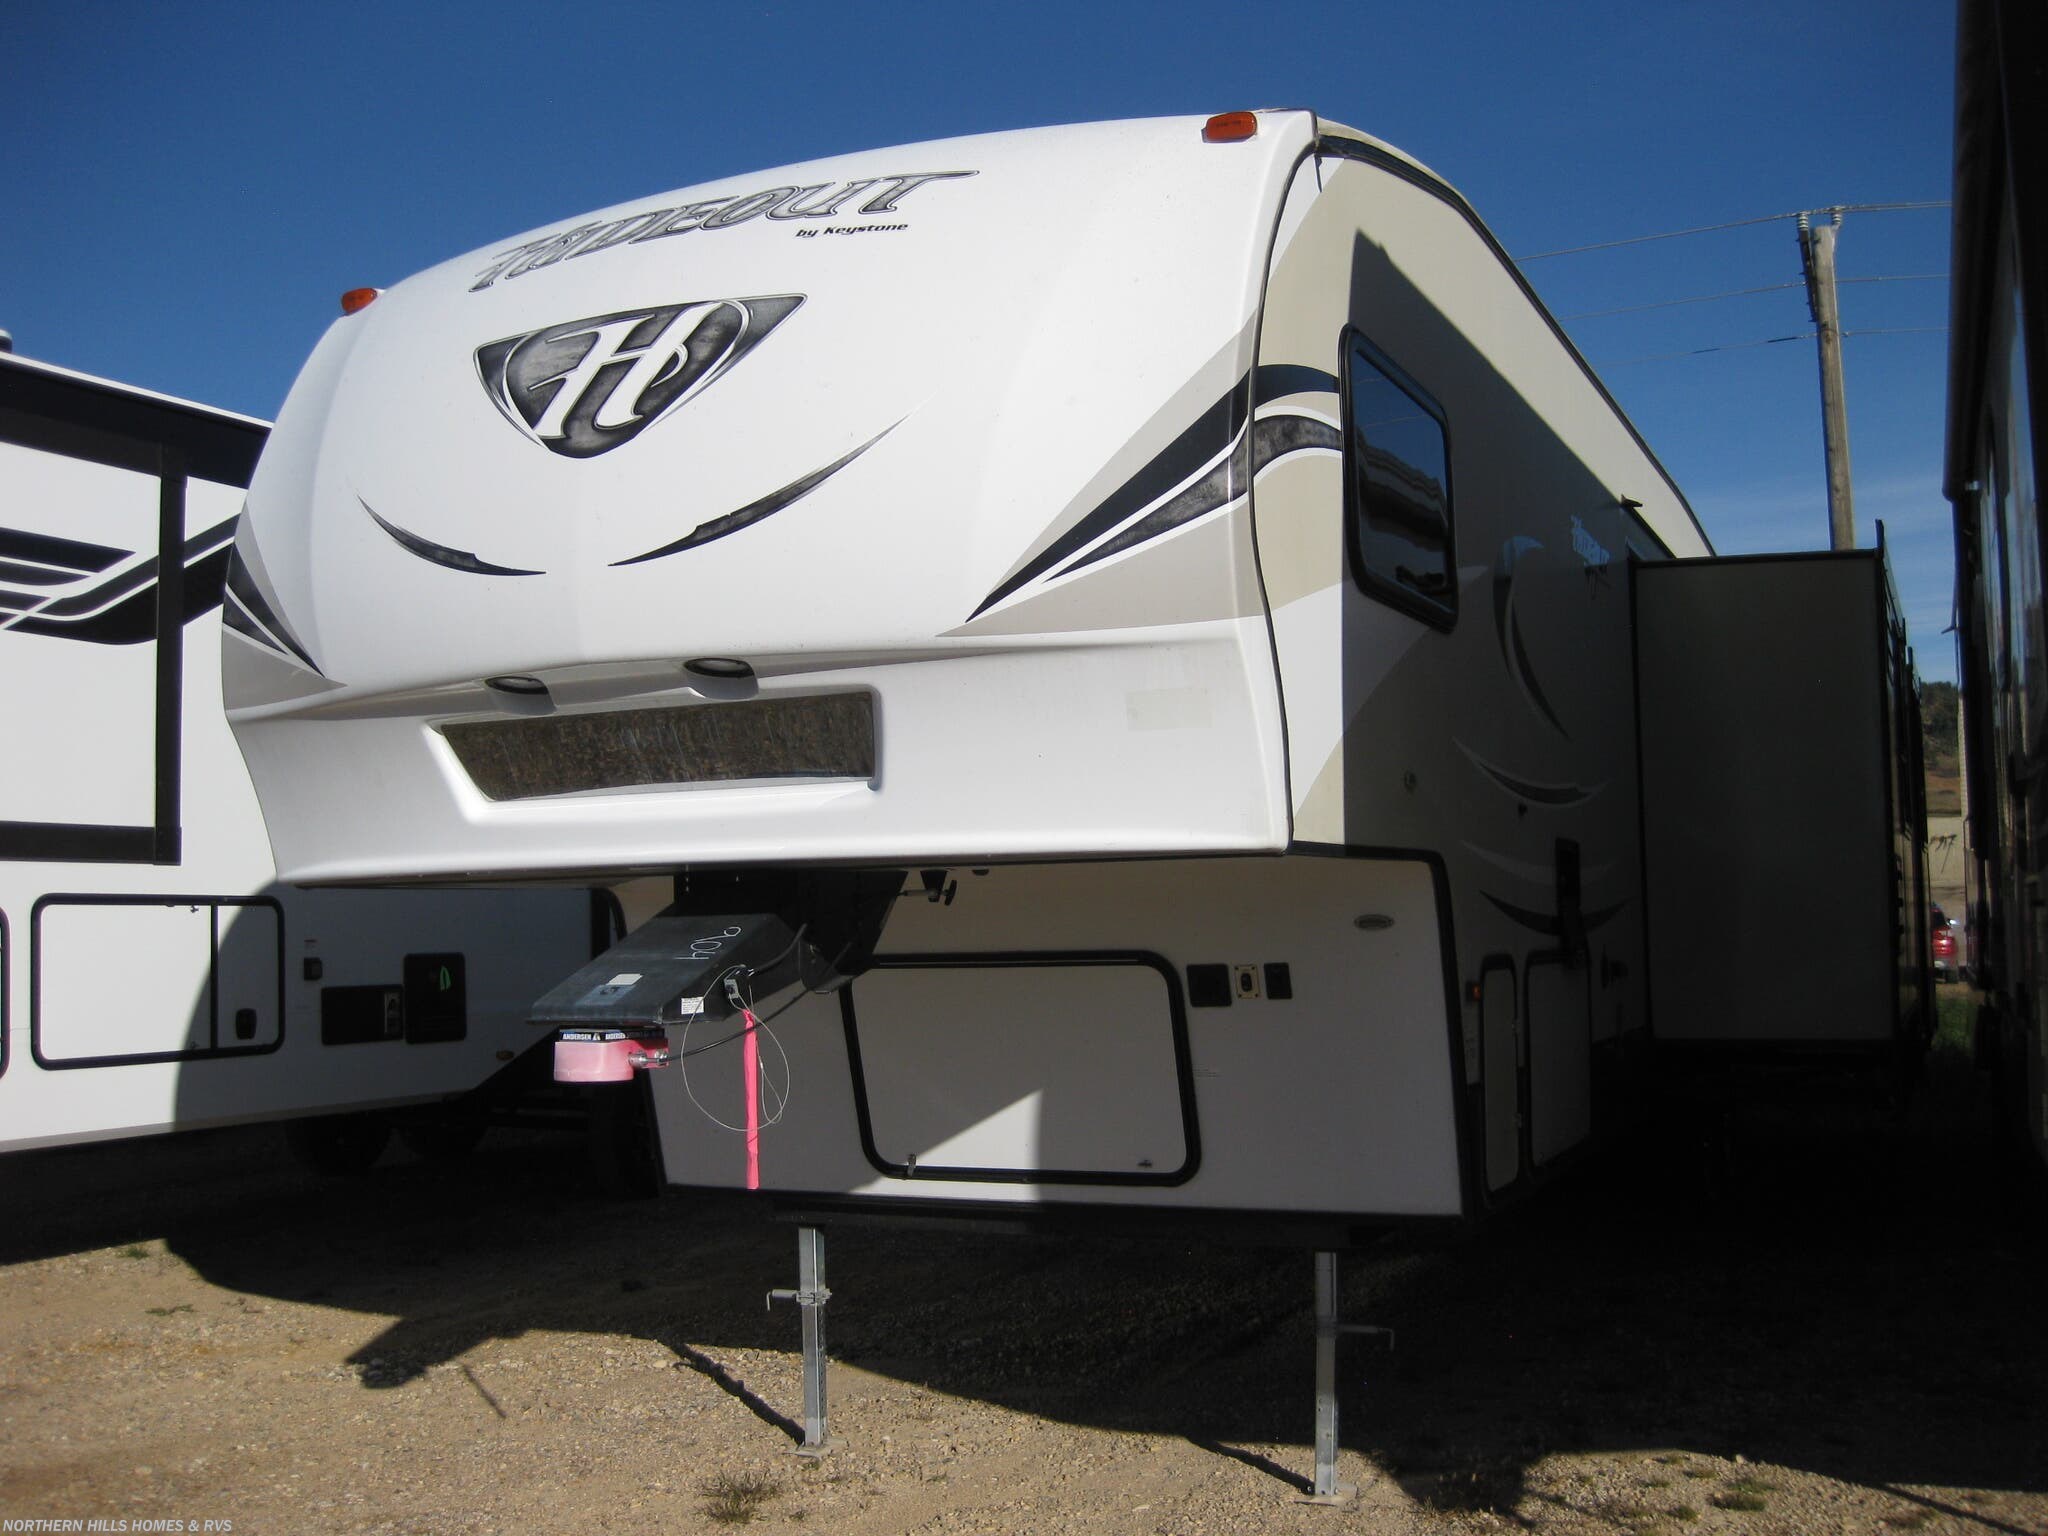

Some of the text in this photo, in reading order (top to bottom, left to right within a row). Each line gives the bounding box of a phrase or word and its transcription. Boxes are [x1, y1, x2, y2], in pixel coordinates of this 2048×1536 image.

[468, 170, 979, 292] HIDEOUT
[795, 224, 908, 238] by Keystone
